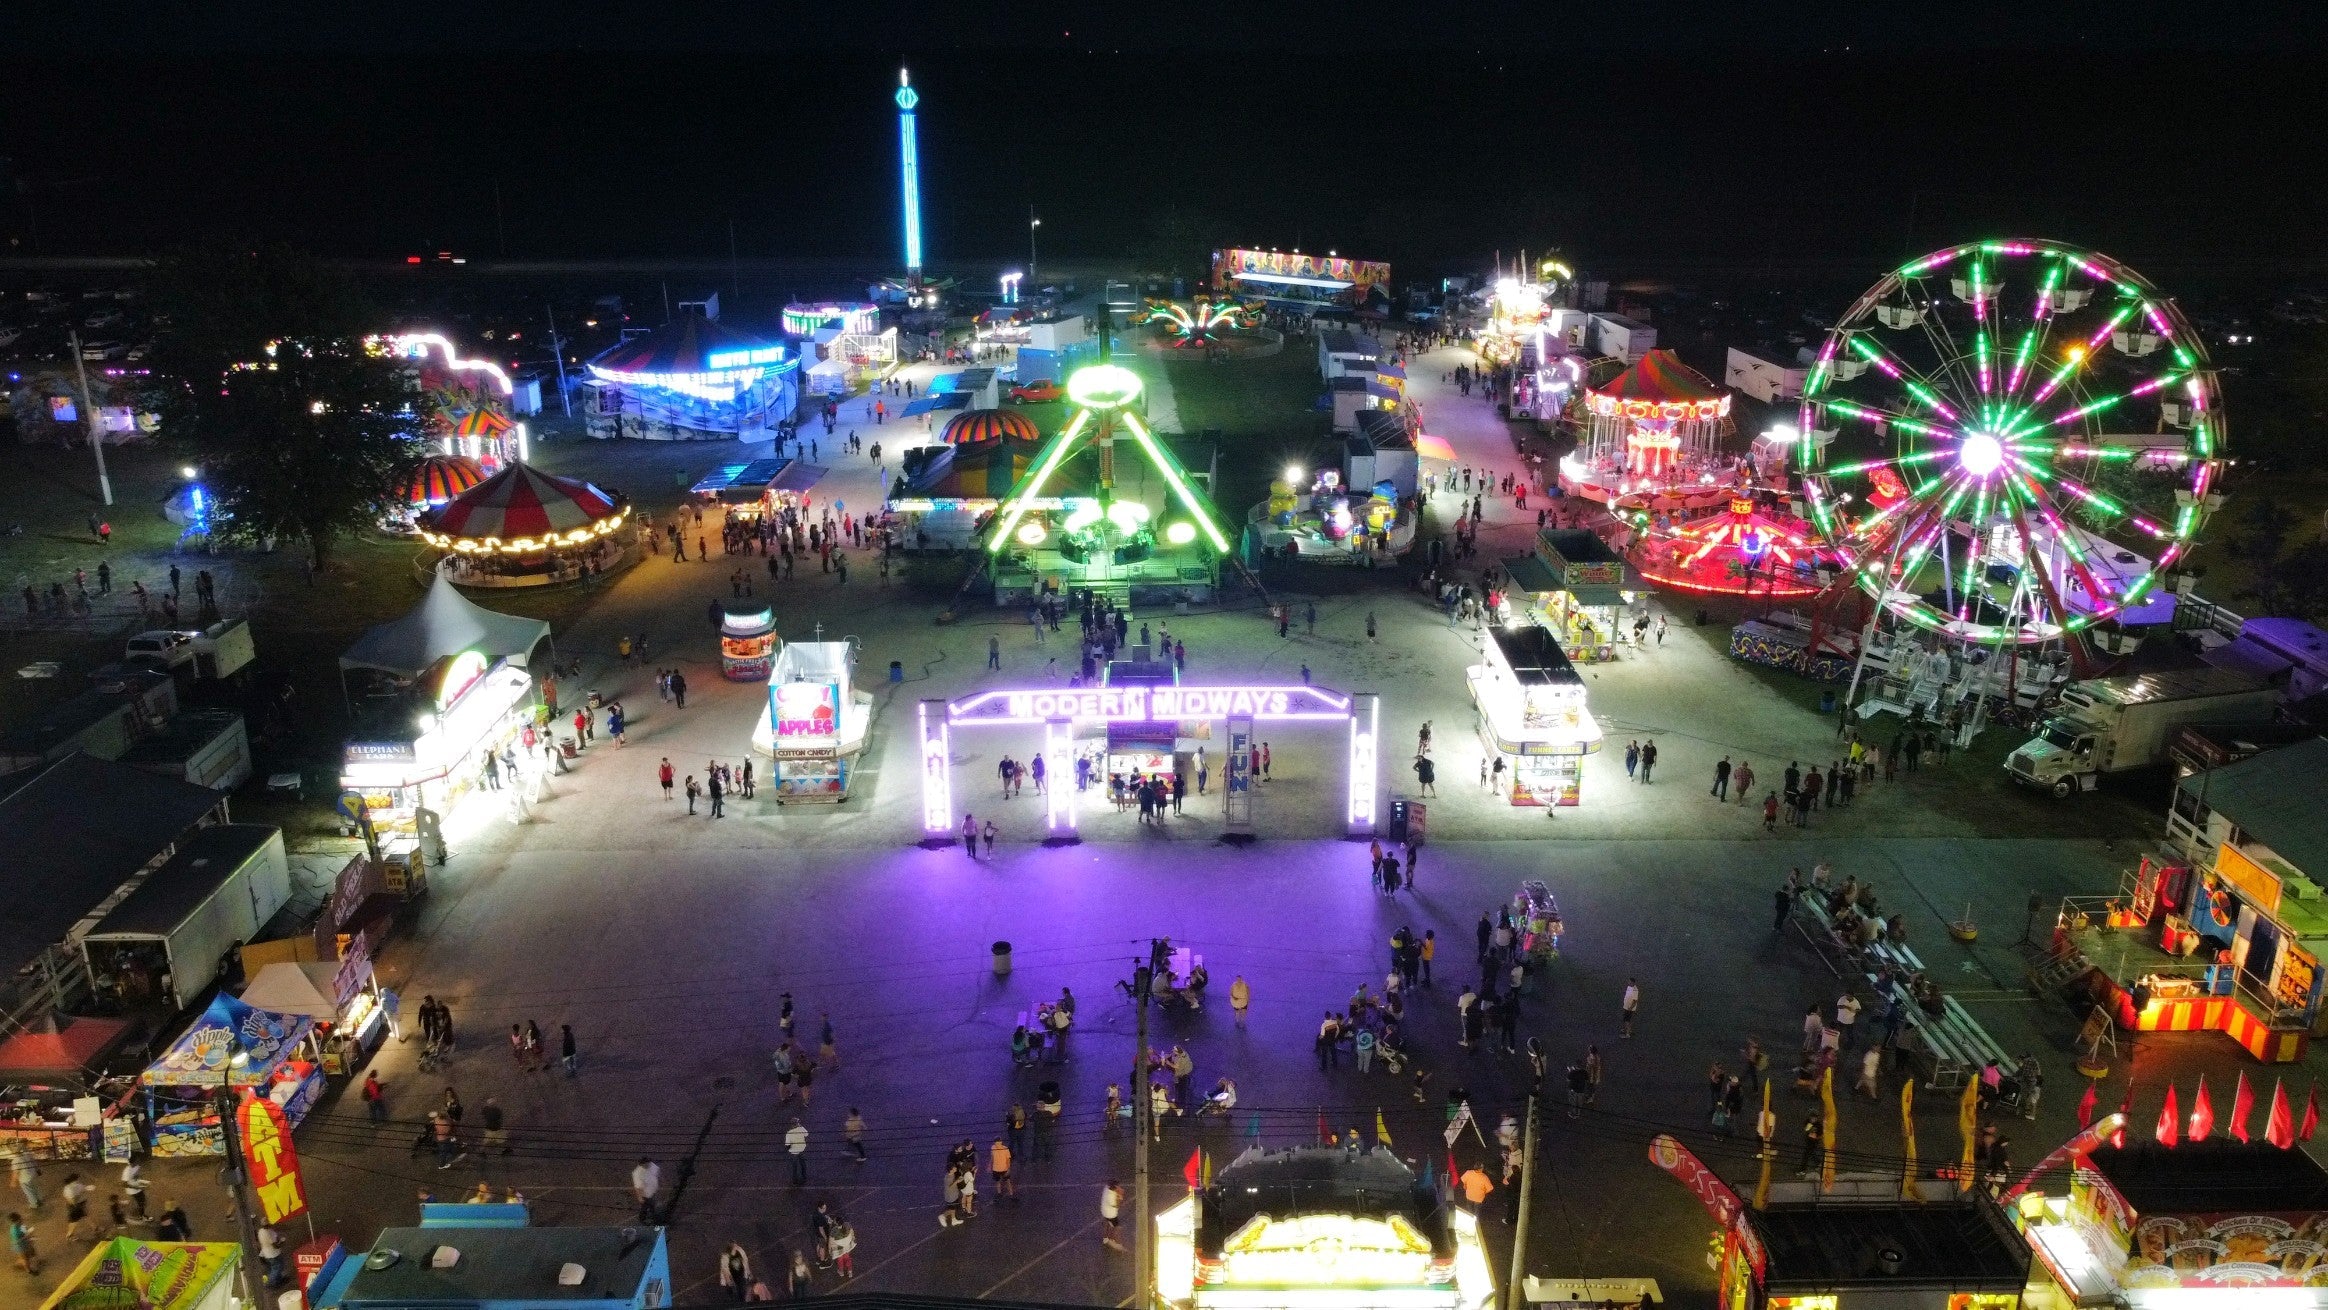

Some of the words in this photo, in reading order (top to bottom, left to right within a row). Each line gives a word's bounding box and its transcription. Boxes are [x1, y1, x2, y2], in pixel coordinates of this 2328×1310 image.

[1009, 694, 1145, 718] MODERN
[1152, 691, 1287, 715] MIDWAYS
[778, 720, 834, 736] APPLES
[351, 746, 407, 754] ELEPHANT
[777, 749, 806, 757] COTTON
[1230, 734, 1248, 792] FUN
[249, 1101, 304, 1226] ATM
[2217, 1217, 2247, 1230] Chicken
[2249, 1216, 2259, 1224] Or
[2277, 1240, 2315, 1248] SAUSAGE
[300, 1255, 321, 1263] ATM
